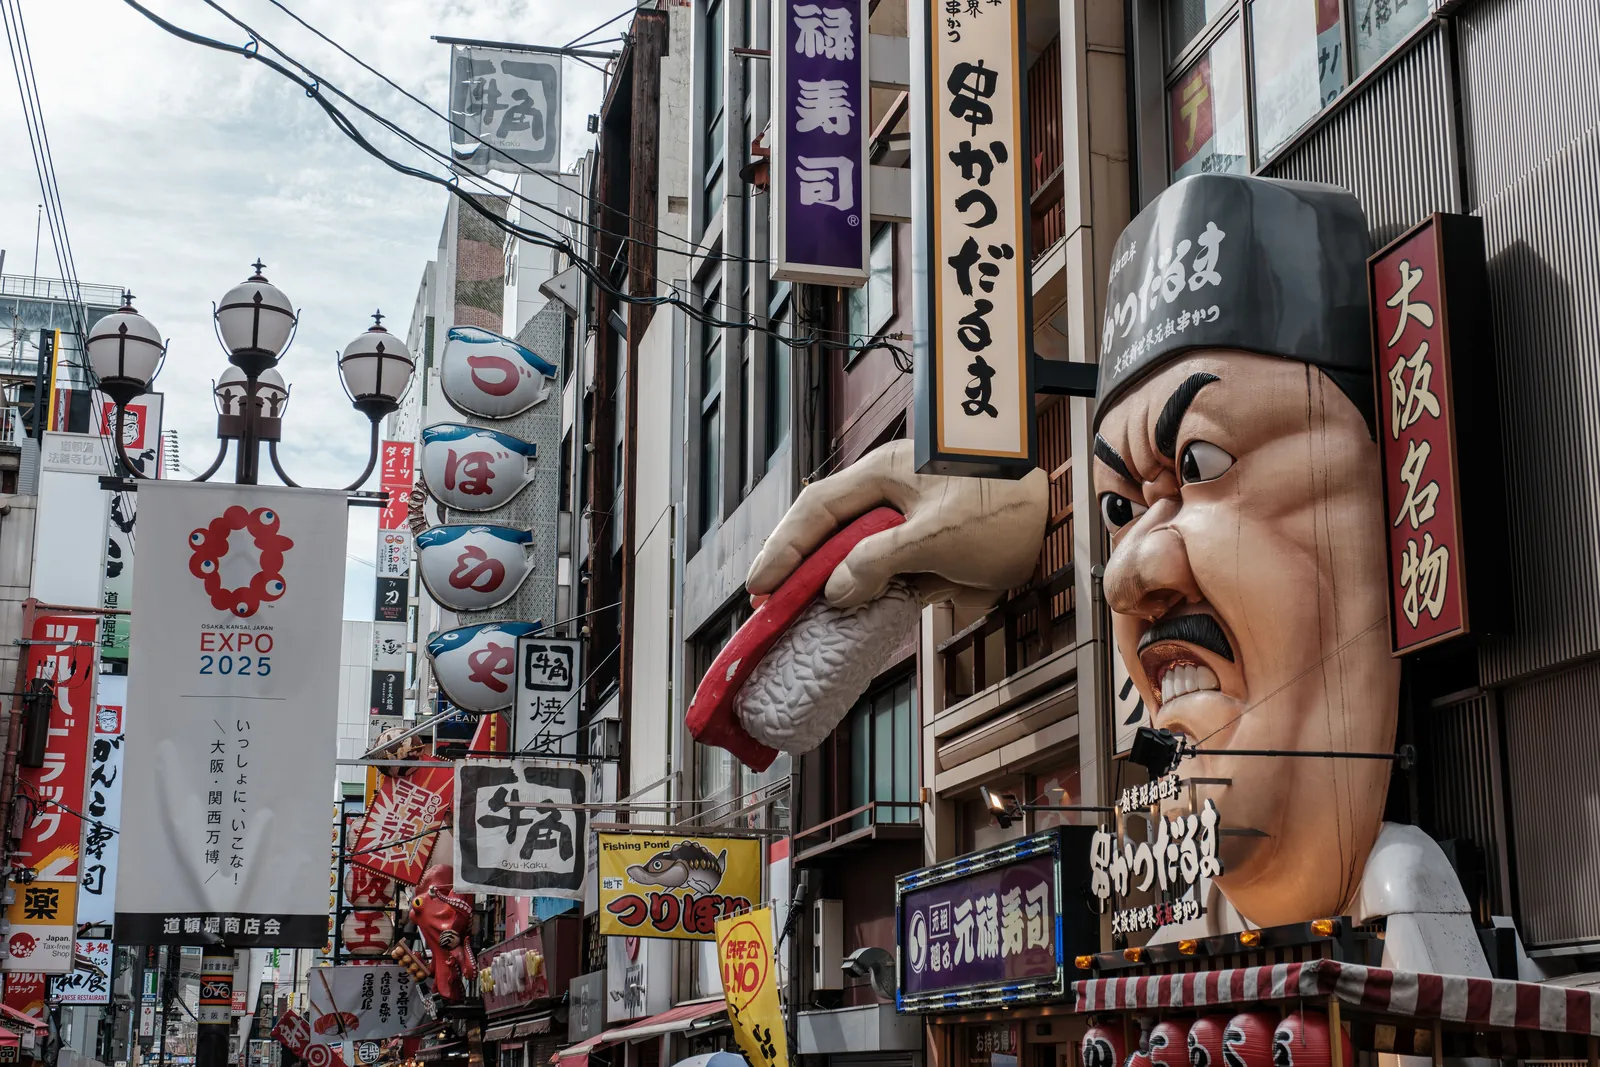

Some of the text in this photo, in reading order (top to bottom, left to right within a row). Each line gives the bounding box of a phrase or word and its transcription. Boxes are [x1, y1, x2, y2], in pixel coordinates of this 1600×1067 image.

[946, 59, 1014, 418] 串かつだるま
[1386, 259, 1449, 628] 大阪名物
[48, 452, 103, 467] 法善寺ビル
[201, 623, 274, 633] OSAKA, KANSAI, JAPAN
[199, 632, 274, 654] EXPO
[199, 655, 271, 677] 2025
[531, 652, 568, 681] 牛角
[529, 696, 566, 755] 焼肉
[1119, 774, 1181, 814] 創業昭和四年
[476, 786, 574, 862] 牛角
[602, 840, 670, 852] Fishing Pond
[1090, 798, 1224, 914] 串かつだるま
[501, 859, 548, 870] Gyu-Kaku
[602, 878, 623, 890] 地下
[24, 887, 59, 920] 薬
[163, 917, 281, 936] 道頓堀商店会
[953, 881, 1050, 966] 元禄寿司
[43, 943, 70, 951] Tax-free
[52, 951, 70, 959] Shop
[8, 985, 37, 994] ドラッグ
[361, 972, 375, 1011] 居酒屋
